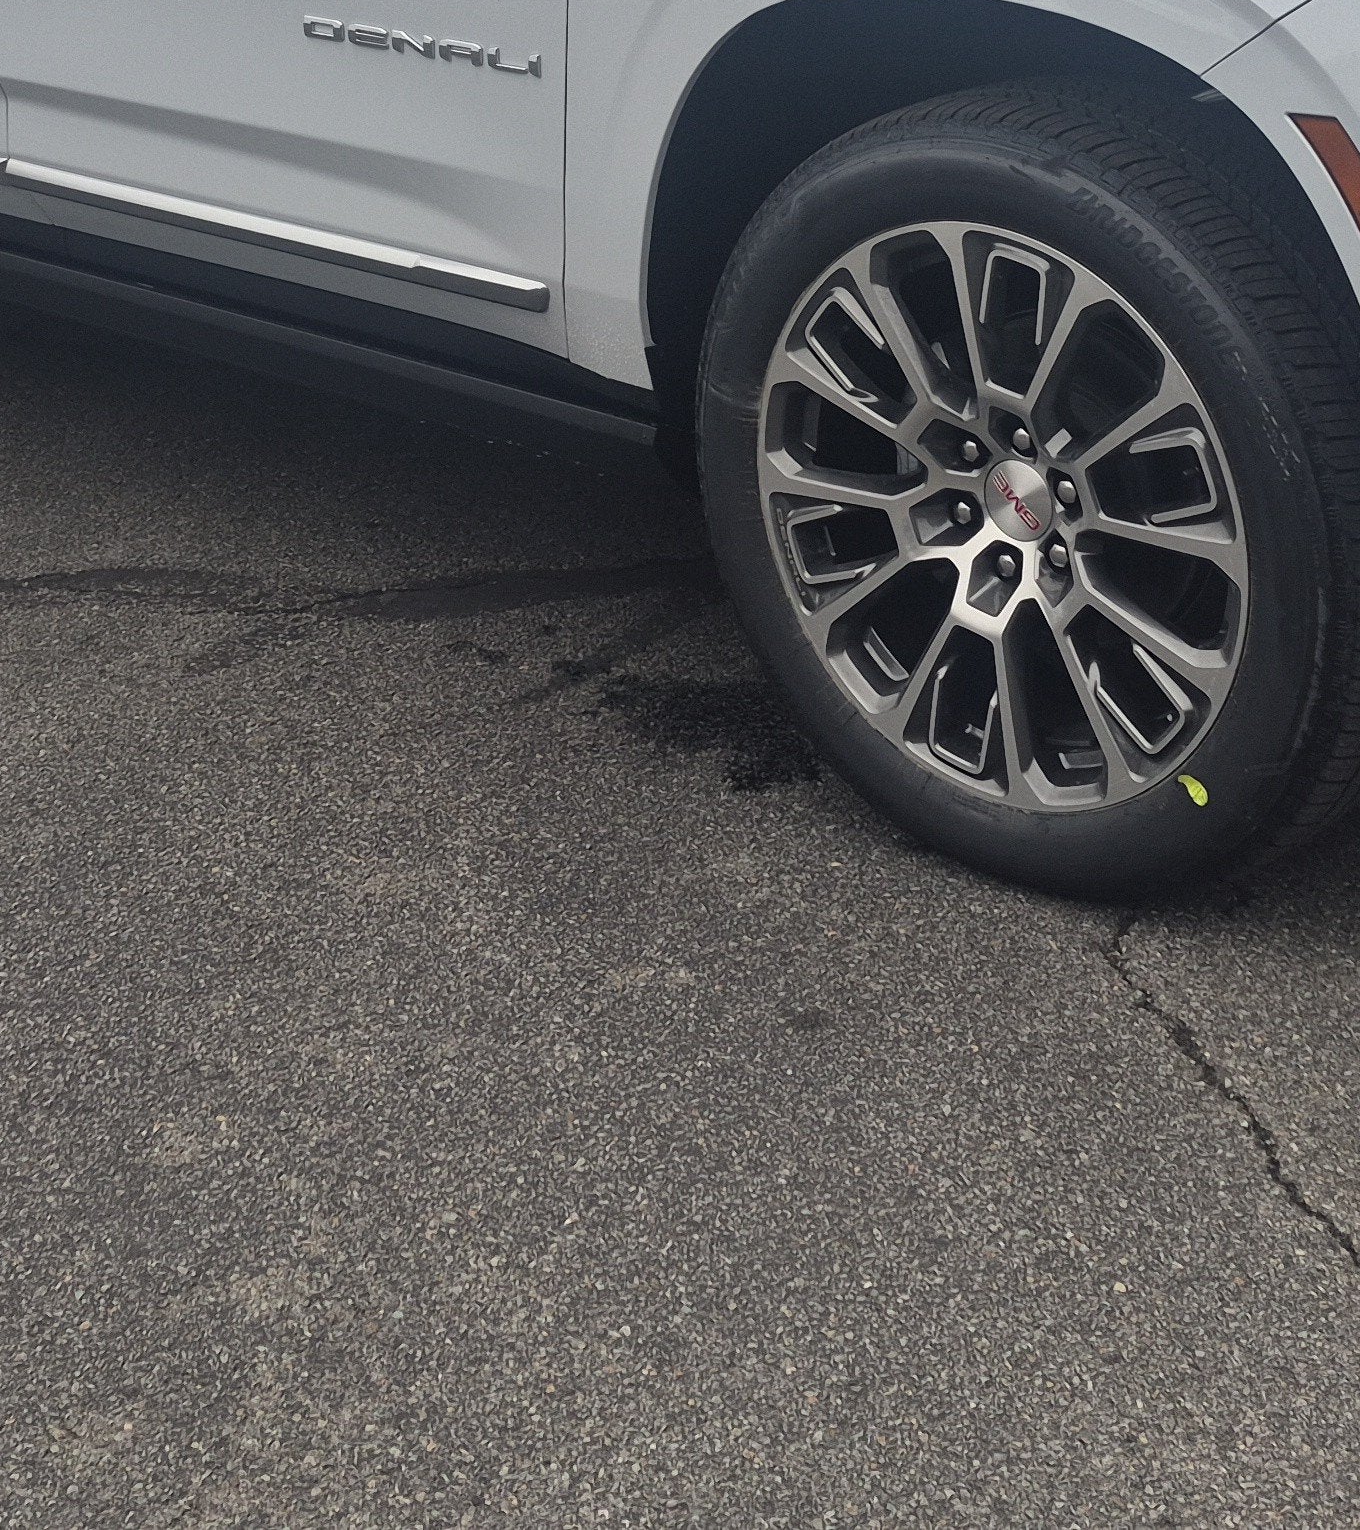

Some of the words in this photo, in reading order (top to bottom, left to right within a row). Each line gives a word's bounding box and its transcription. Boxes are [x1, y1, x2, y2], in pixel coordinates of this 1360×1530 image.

[303, 15, 542, 79] DENALI
[1068, 186, 1246, 366] BRIDGESTONE
[991, 470, 1042, 532] GMC
